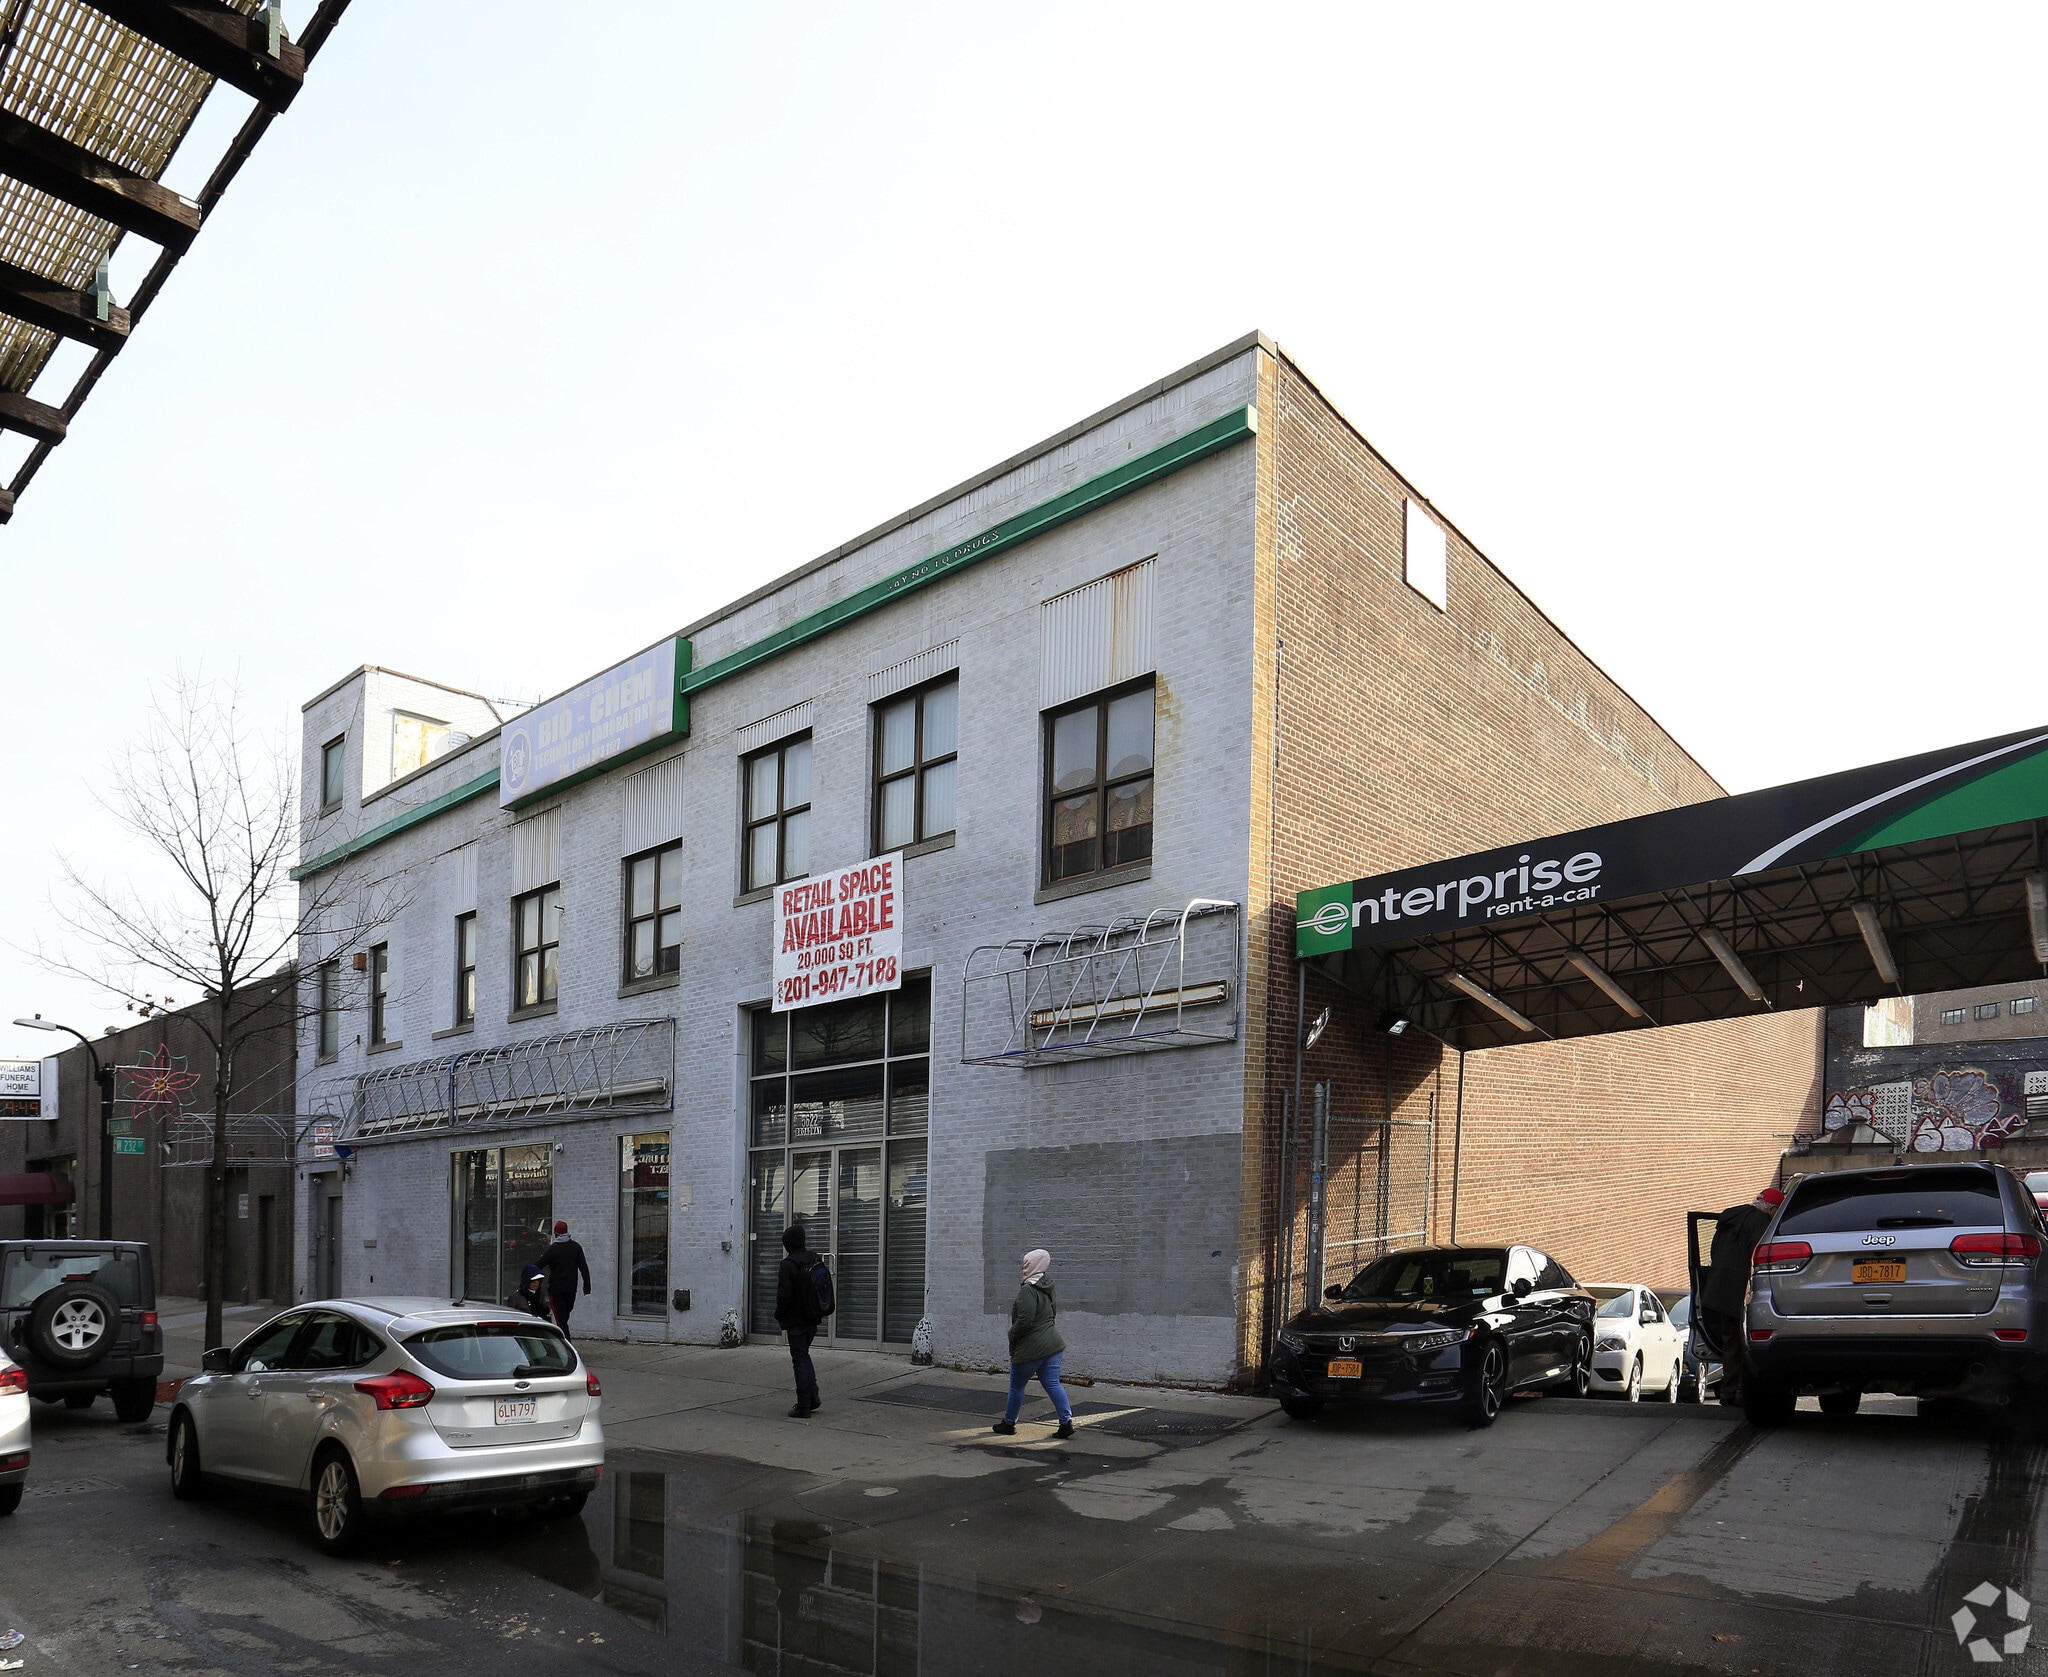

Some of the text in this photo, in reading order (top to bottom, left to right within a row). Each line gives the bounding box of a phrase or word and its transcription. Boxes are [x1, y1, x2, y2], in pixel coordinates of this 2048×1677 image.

[911, 566, 929, 579] NO
[954, 530, 1000, 558] DRUGS
[538, 708, 573, 750] BIO
[590, 667, 652, 724] CHEM
[533, 730, 591, 771] TECHNOLOGY
[782, 861, 893, 917] RETAIL SPACE
[1297, 851, 1602, 935] enterprise
[1486, 885, 1601, 919] rent-a-car
[782, 892, 894, 954] AVAILABLE
[797, 946, 835, 971] 20,000
[839, 941, 854, 961] SQ
[784, 955, 898, 1003] 201-947-7188
[0, 1065, 36, 1073] WILLIAMS
[0, 1074, 36, 1082] FUNERAL
[7, 1083, 29, 1091] HOME
[124, 1140, 137, 1152] 232
[1862, 1234, 1896, 1247] Jeep
[498, 1402, 536, 1418] 6LH 797
